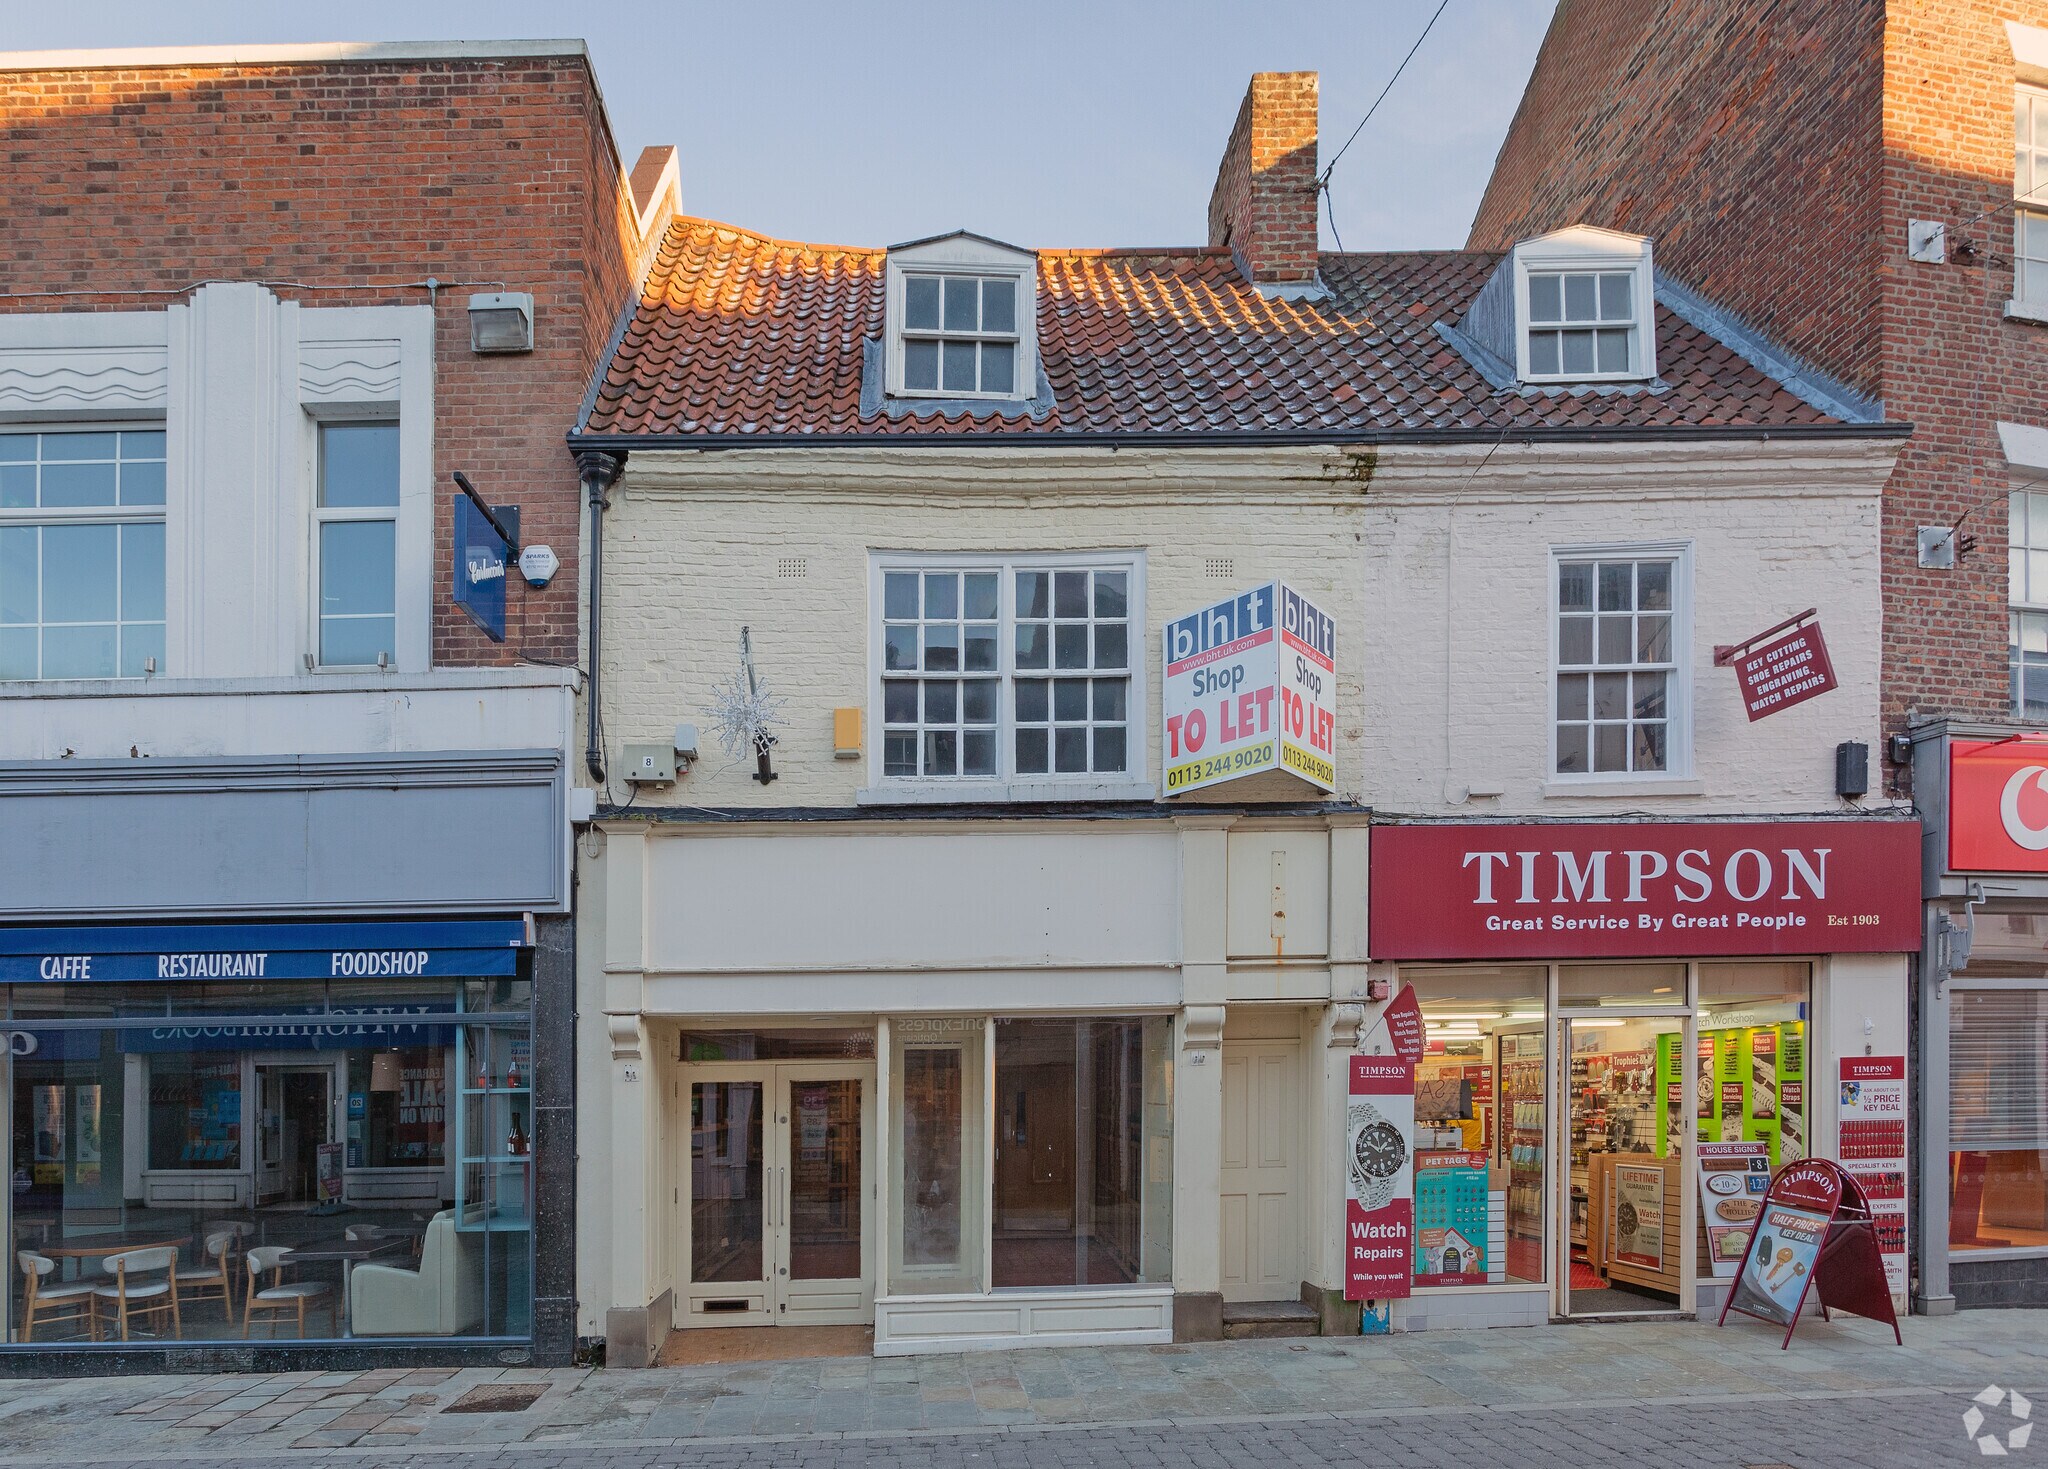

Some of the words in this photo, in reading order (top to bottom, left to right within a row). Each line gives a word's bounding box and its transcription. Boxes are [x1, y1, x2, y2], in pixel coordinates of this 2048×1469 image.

[1172, 591, 1264, 662] bht
[1285, 588, 1331, 657] bht
[1182, 637, 1256, 671] www.bht.uk.com
[1289, 637, 1327, 668] www.bht.uk.com
[1746, 657, 1763, 673] KEY
[1766, 637, 1806, 663] CUTTING
[1747, 668, 1771, 686] SHOE
[1772, 649, 1813, 675] REPAIRS
[1193, 664, 1245, 697] Shop
[1296, 656, 1322, 702] Shop
[1750, 692, 1782, 712] WATCH
[1784, 673, 1826, 698] REPAIRS
[1167, 708, 1207, 759] TO
[1220, 685, 1274, 744] LET
[1282, 685, 1304, 739] TO
[1309, 702, 1334, 755] LET
[645, 757, 652, 767] 8
[1168, 765, 1201, 787] 0113
[1205, 756, 1232, 778] 244
[1234, 745, 1272, 770] 9020
[1283, 745, 1302, 767] 0113
[1303, 755, 1316, 774] 244
[1316, 762, 1333, 783] 9020
[1462, 848, 1832, 904] TIMPSON
[1486, 915, 1543, 931] Great
[1551, 914, 1630, 930] Service
[1638, 913, 1664, 932] By
[1671, 913, 1729, 929] Great
[1737, 912, 1807, 931] People
[1827, 914, 1849, 926] Est
[1852, 914, 1880, 926] 1903
[40, 956, 92, 980] CAFFE
[158, 953, 268, 978] RESTAURANT
[331, 951, 429, 976] FOODSHOP
[1699, 1018, 1710, 1027] tch
[1712, 1014, 1755, 1025] Workshop
[1754, 1044, 1771, 1052] Straps
[1614, 1055, 1639, 1067] Trophies
[1359, 1066, 1406, 1075] TIMPSON
[1853, 1065, 1892, 1074] TIMPSON
[1783, 1093, 1801, 1102] Straps
[1874, 1094, 1901, 1103] PRICE
[1863, 1104, 1878, 1112] KEY
[1880, 1103, 1900, 1111] DEAL
[1706, 1146, 1733, 1154] HOUSE
[1735, 1145, 1758, 1153] SIGNS
[1425, 1158, 1442, 1166] PET
[1444, 1156, 1468, 1165] TAGS
[1756, 1159, 1763, 1170] 8
[1848, 1162, 1880, 1170] SPECIALIST
[1622, 1171, 1659, 1184] LIFETIME
[1751, 1177, 1768, 1190] 127
[1781, 1170, 1836, 1195] TIMPSON
[1626, 1182, 1654, 1191] GUARANTEE
[1721, 1180, 1730, 1189] 10
[1639, 1208, 1661, 1220] Watch
[1725, 1207, 1756, 1216] HOLLIES
[1639, 1218, 1661, 1227] Batteries
[1772, 1214, 1794, 1227] HALF
[1794, 1218, 1820, 1232] PRICE
[1351, 1221, 1407, 1239] Watch
[1781, 1228, 1795, 1239] KEY
[1796, 1231, 1815, 1243] DEAL
[1354, 1246, 1404, 1262] Repairs
[1353, 1273, 1373, 1281] While
[1388, 1272, 1404, 1280] wait
